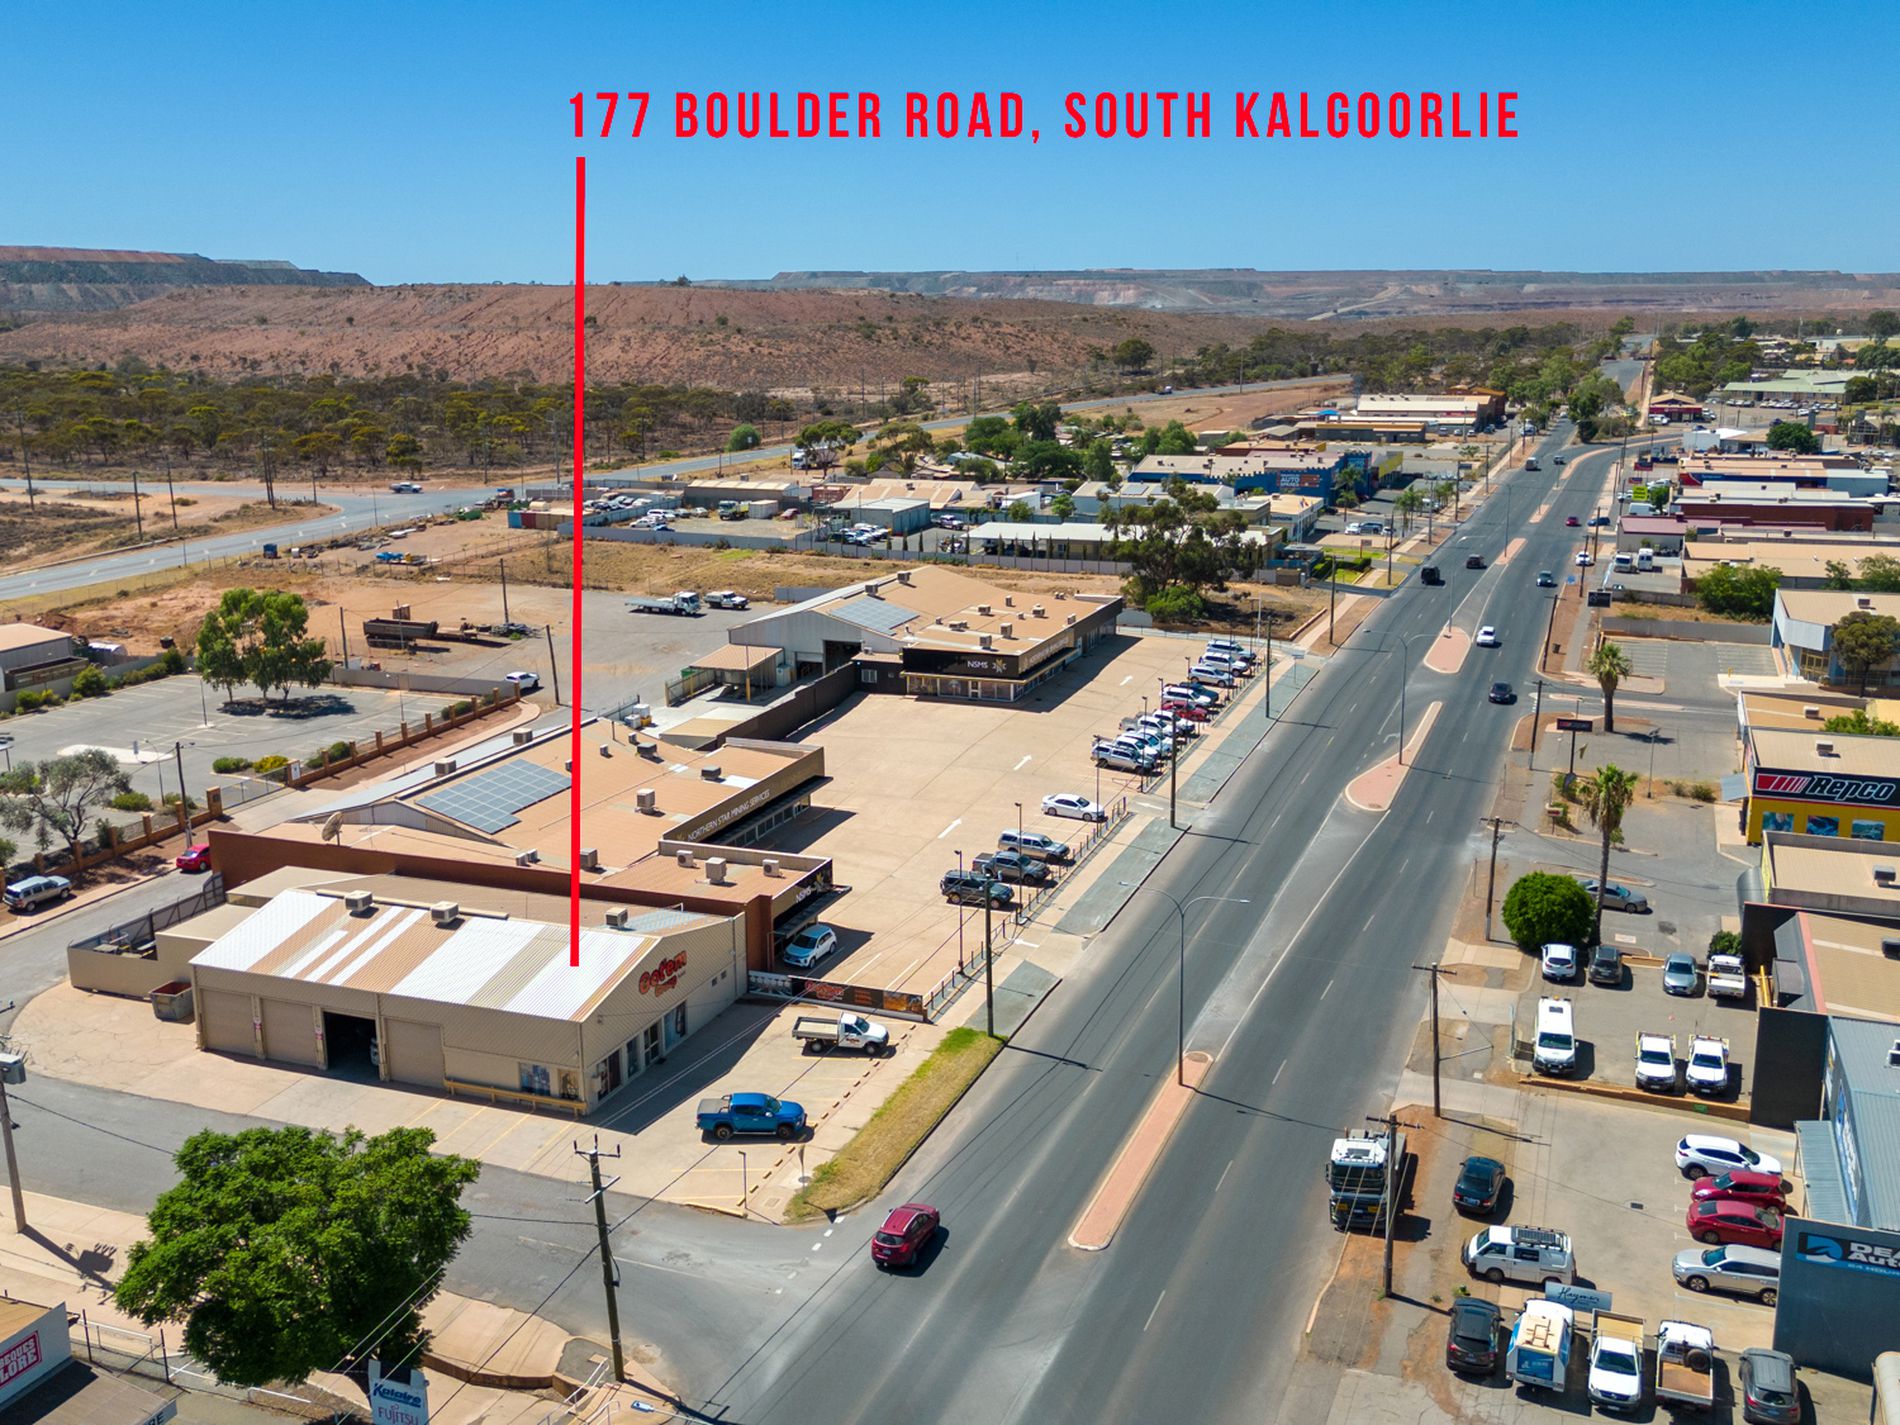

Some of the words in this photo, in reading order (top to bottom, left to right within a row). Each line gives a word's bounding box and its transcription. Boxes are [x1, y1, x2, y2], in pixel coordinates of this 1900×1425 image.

[967, 660, 989, 669] NSMS
[1805, 775, 1897, 801] Repco
[687, 818, 718, 841] NORTHERN
[717, 811, 731, 825] STAR
[730, 801, 750, 818] MINING
[749, 788, 770, 807] SERVICES
[1847, 1252, 1900, 1269] Aut
[377, 1406, 421, 1425] FUJITSU
